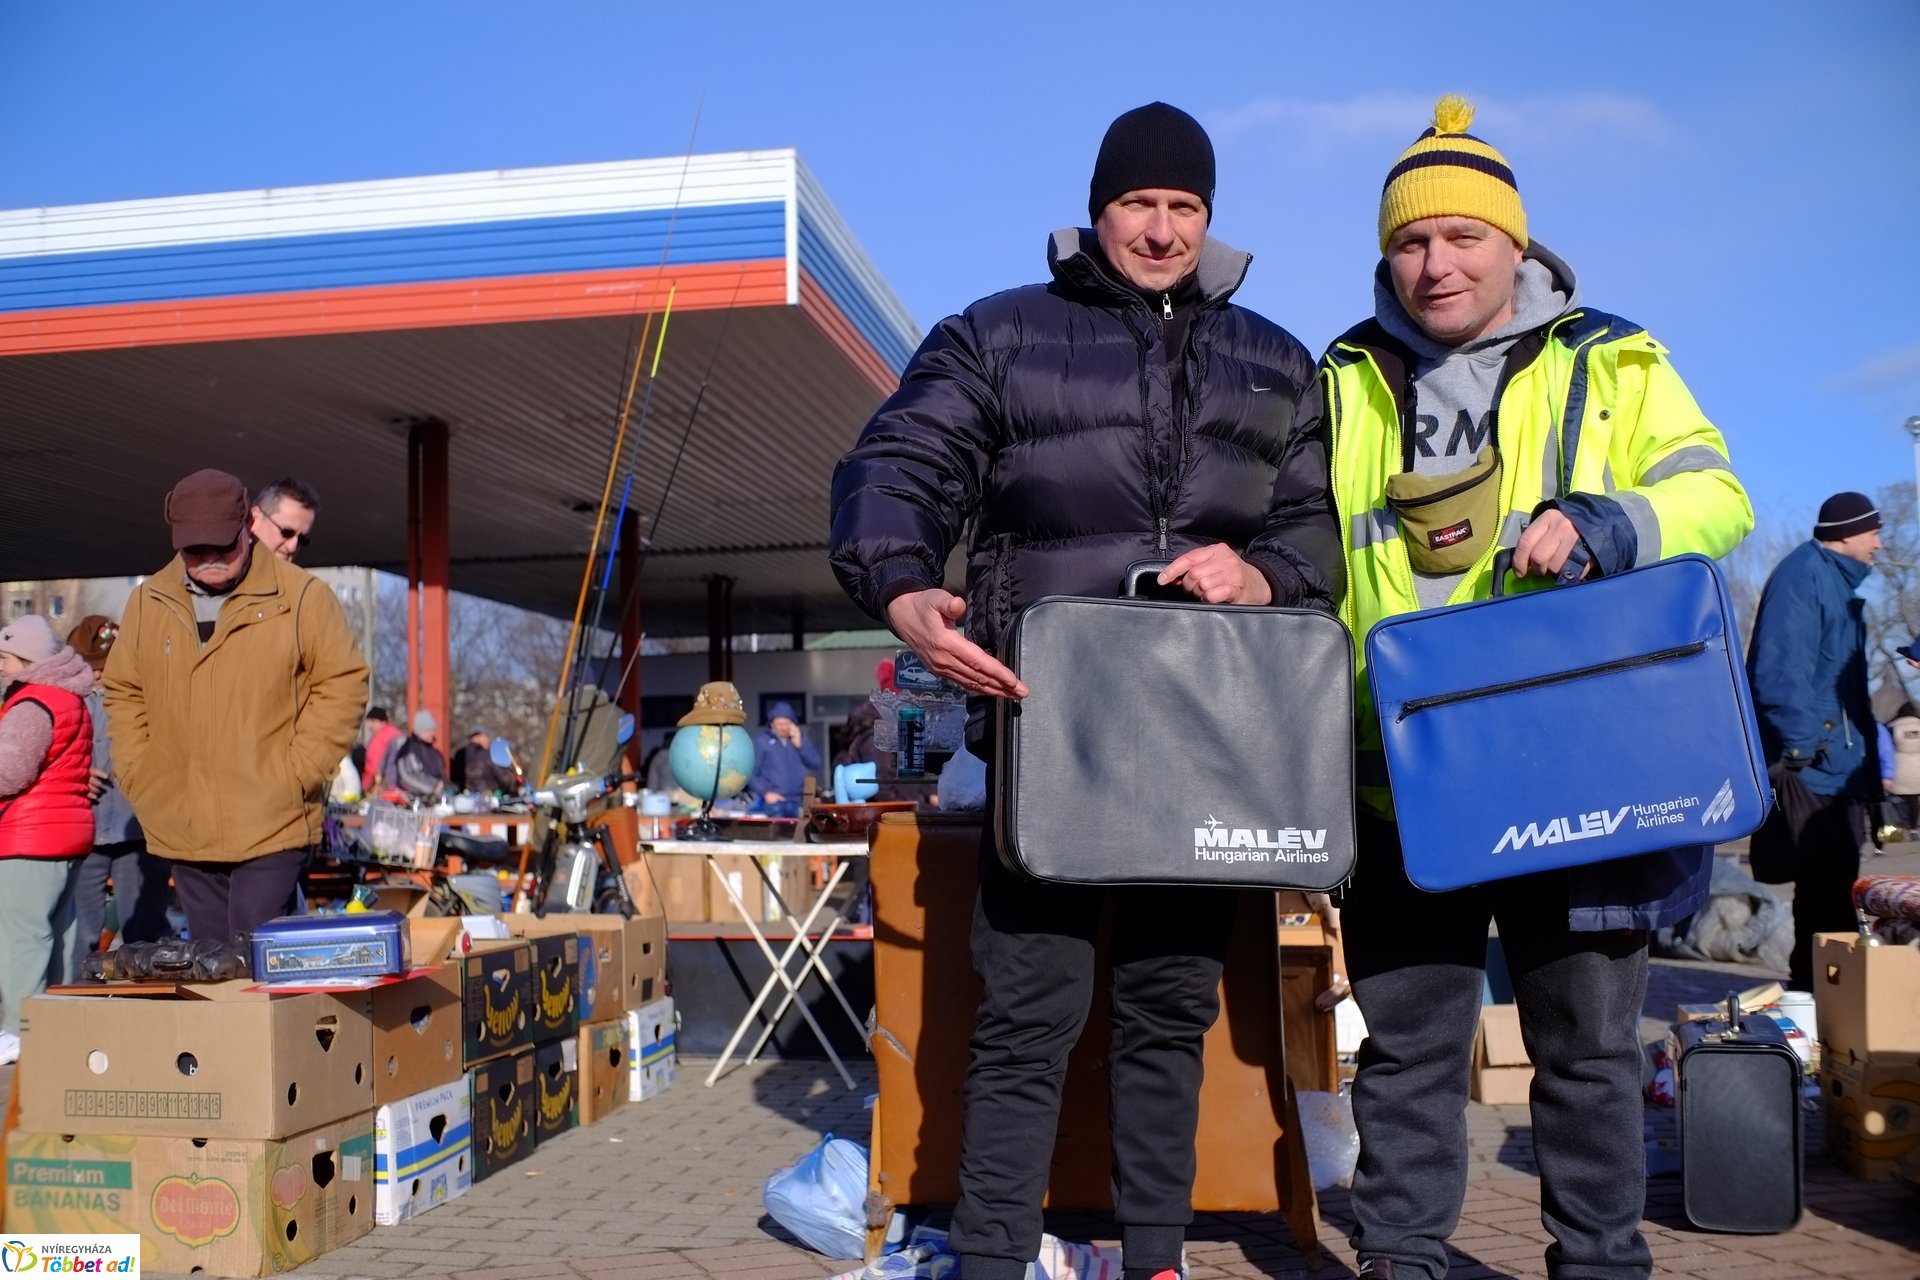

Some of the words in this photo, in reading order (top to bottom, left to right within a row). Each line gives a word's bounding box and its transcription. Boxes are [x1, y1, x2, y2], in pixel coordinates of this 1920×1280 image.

[1434, 527, 1467, 542] EASTPAK
[913, 730, 925, 765] HELL
[1632, 796, 1700, 817] Hungarian
[1636, 811, 1685, 829] Airlines
[1194, 847, 1270, 864] Hungarian
[1275, 849, 1329, 863] Airlines
[68, 1096, 73, 1111] 1
[78, 1096, 83, 1111] 2
[88, 1096, 93, 1111] 3
[98, 1096, 103, 1111] 4
[109, 1096, 114, 1111] 5
[119, 1096, 124, 1111] 6
[130, 1096, 135, 1112] 7
[140, 1096, 145, 1112] 8
[150, 1096, 155, 1112] 9
[159, 1096, 168, 1112] 10
[170, 1095, 177, 1113] 11
[180, 1095, 188, 1113] 12
[190, 1095, 198, 1113] 13
[200, 1095, 208, 1113] 14
[210, 1095, 219, 1113] 15
[13, 1161, 105, 1185] Premium
[14, 1189, 121, 1212] BANANAS
[159, 1196, 183, 1214] Del
[184, 1197, 233, 1217] Monte
